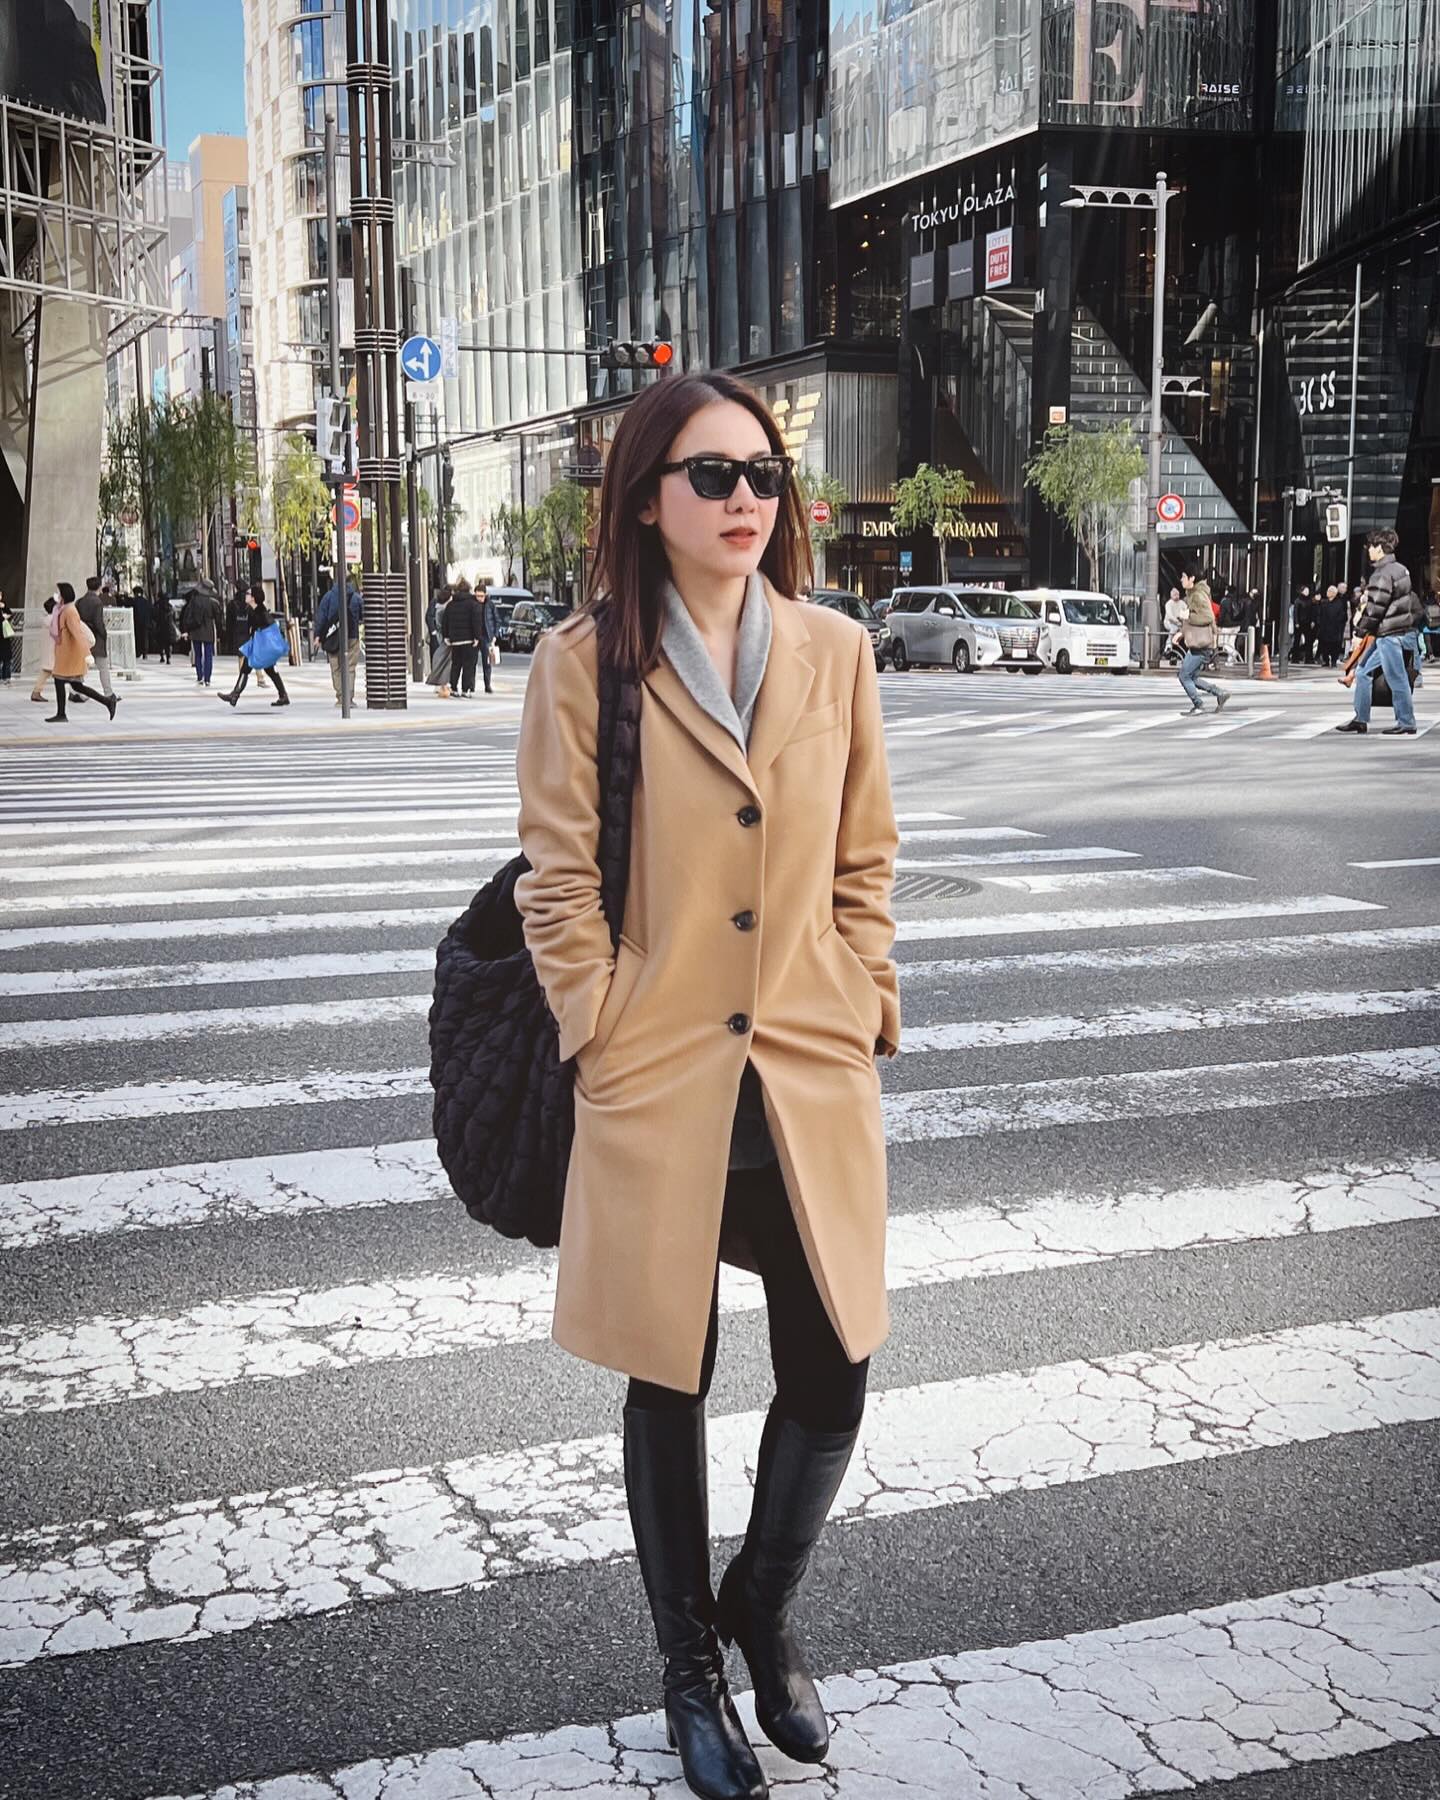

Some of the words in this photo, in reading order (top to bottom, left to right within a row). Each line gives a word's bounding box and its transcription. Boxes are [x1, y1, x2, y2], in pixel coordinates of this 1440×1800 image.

[912, 204, 959, 232] TOKYU
[963, 185, 1015, 216] PLAZA
[990, 251, 1008, 265] DUTY
[990, 263, 1008, 277] FREE
[946, 522, 999, 538] ARMANI
[1252, 534, 1279, 542] TOKYU
